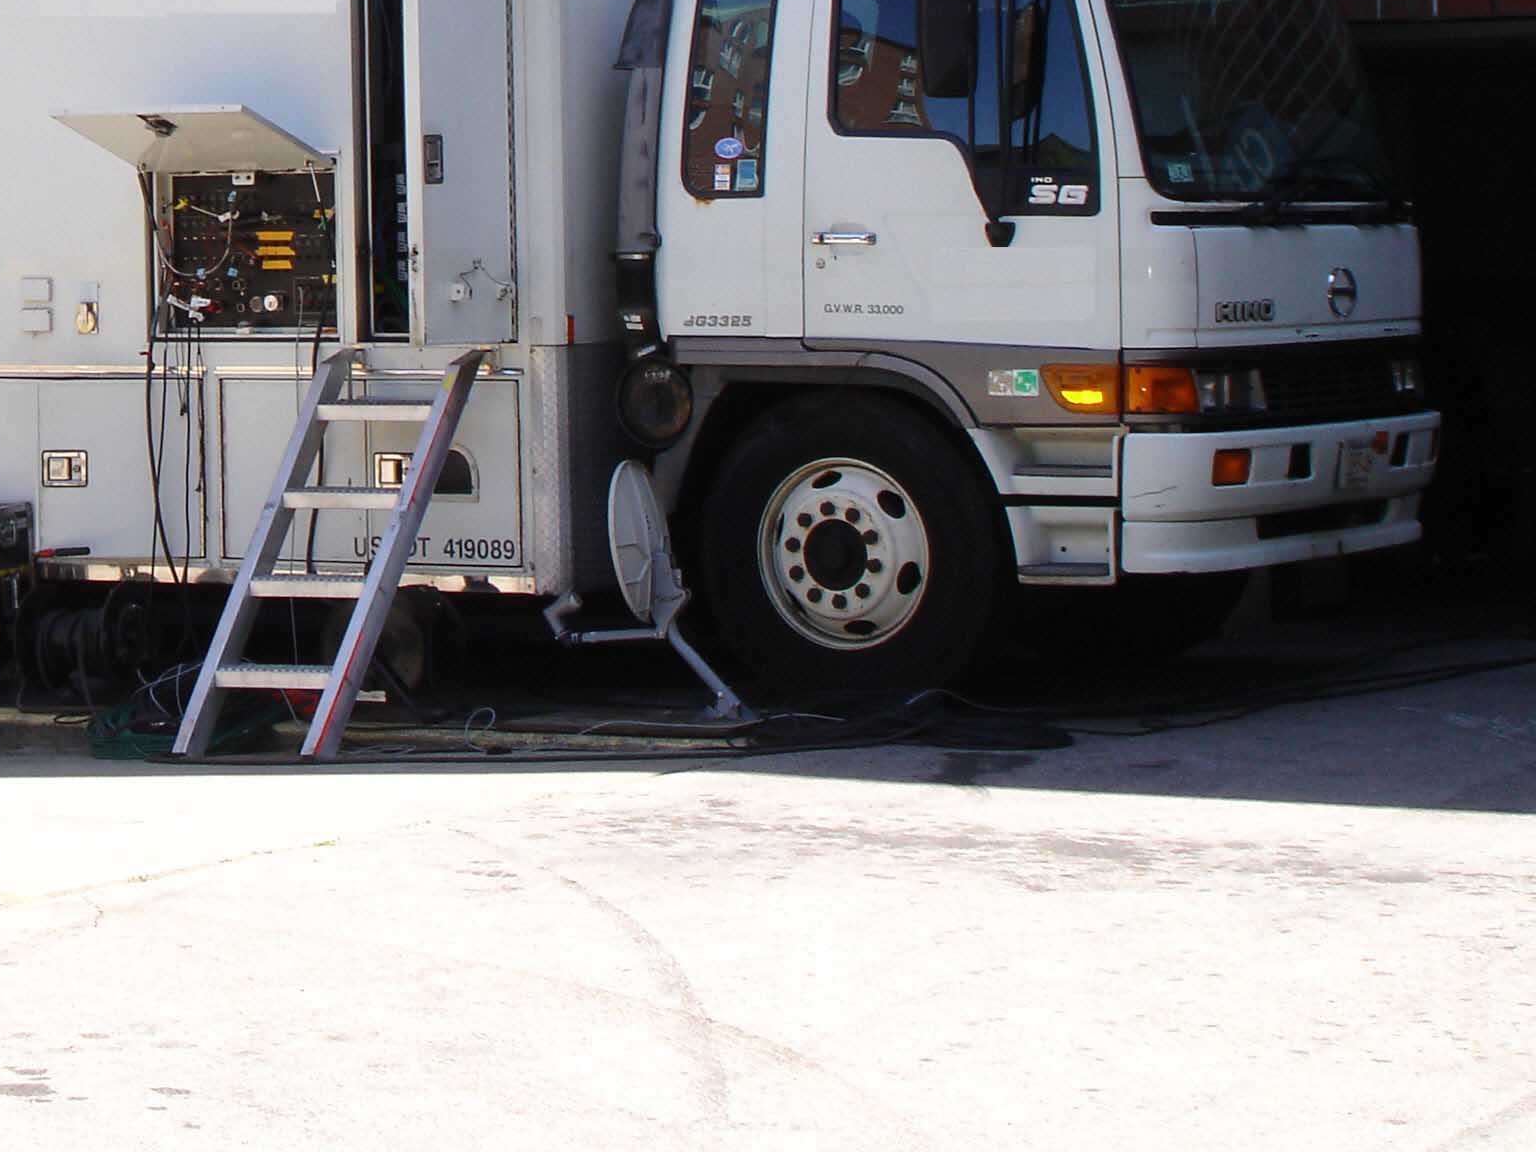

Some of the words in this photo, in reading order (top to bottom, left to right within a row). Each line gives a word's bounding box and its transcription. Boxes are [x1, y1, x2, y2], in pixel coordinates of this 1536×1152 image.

[1028, 184, 1089, 205] SG
[1215, 298, 1274, 323] HINO
[443, 538, 516, 560] 419089
